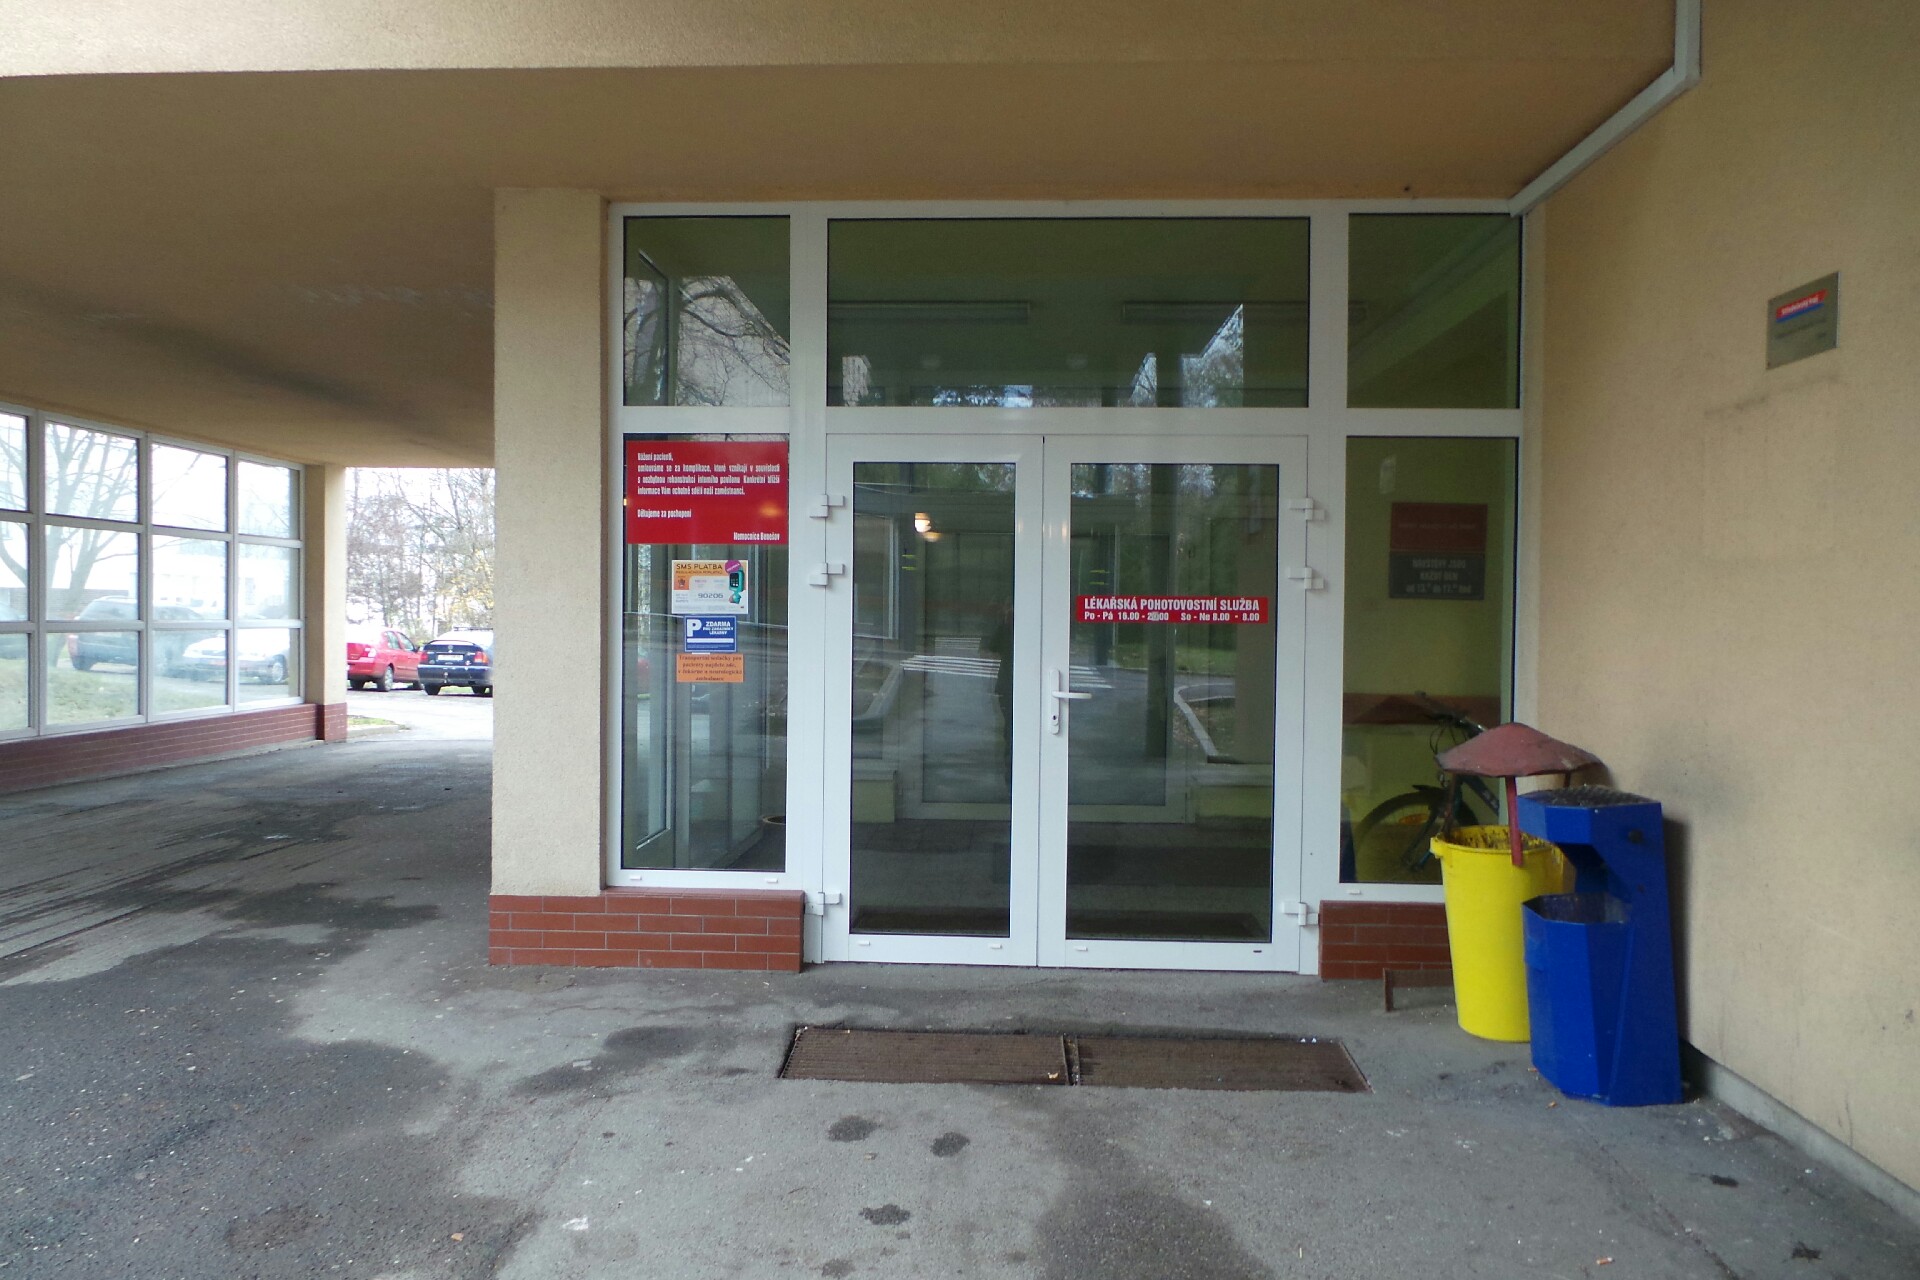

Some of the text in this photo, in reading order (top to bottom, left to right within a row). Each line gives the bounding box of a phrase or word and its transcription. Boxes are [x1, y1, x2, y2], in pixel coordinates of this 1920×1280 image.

[674, 464, 681, 472] za
[661, 510, 667, 518] za
[733, 532, 760, 541] Nemocnice
[1084, 596, 1260, 611] LÉKAŘSKÁ POHOTOVOSTNÍ SLUŽBA
[1084, 612, 1095, 620] Po
[1102, 611, 1113, 620] Pá
[1180, 612, 1191, 621] So
[1199, 612, 1210, 621] Ne
[1212, 612, 1230, 621] 8.00
[1242, 612, 1260, 621] 8.00
[686, 618, 702, 637] P
